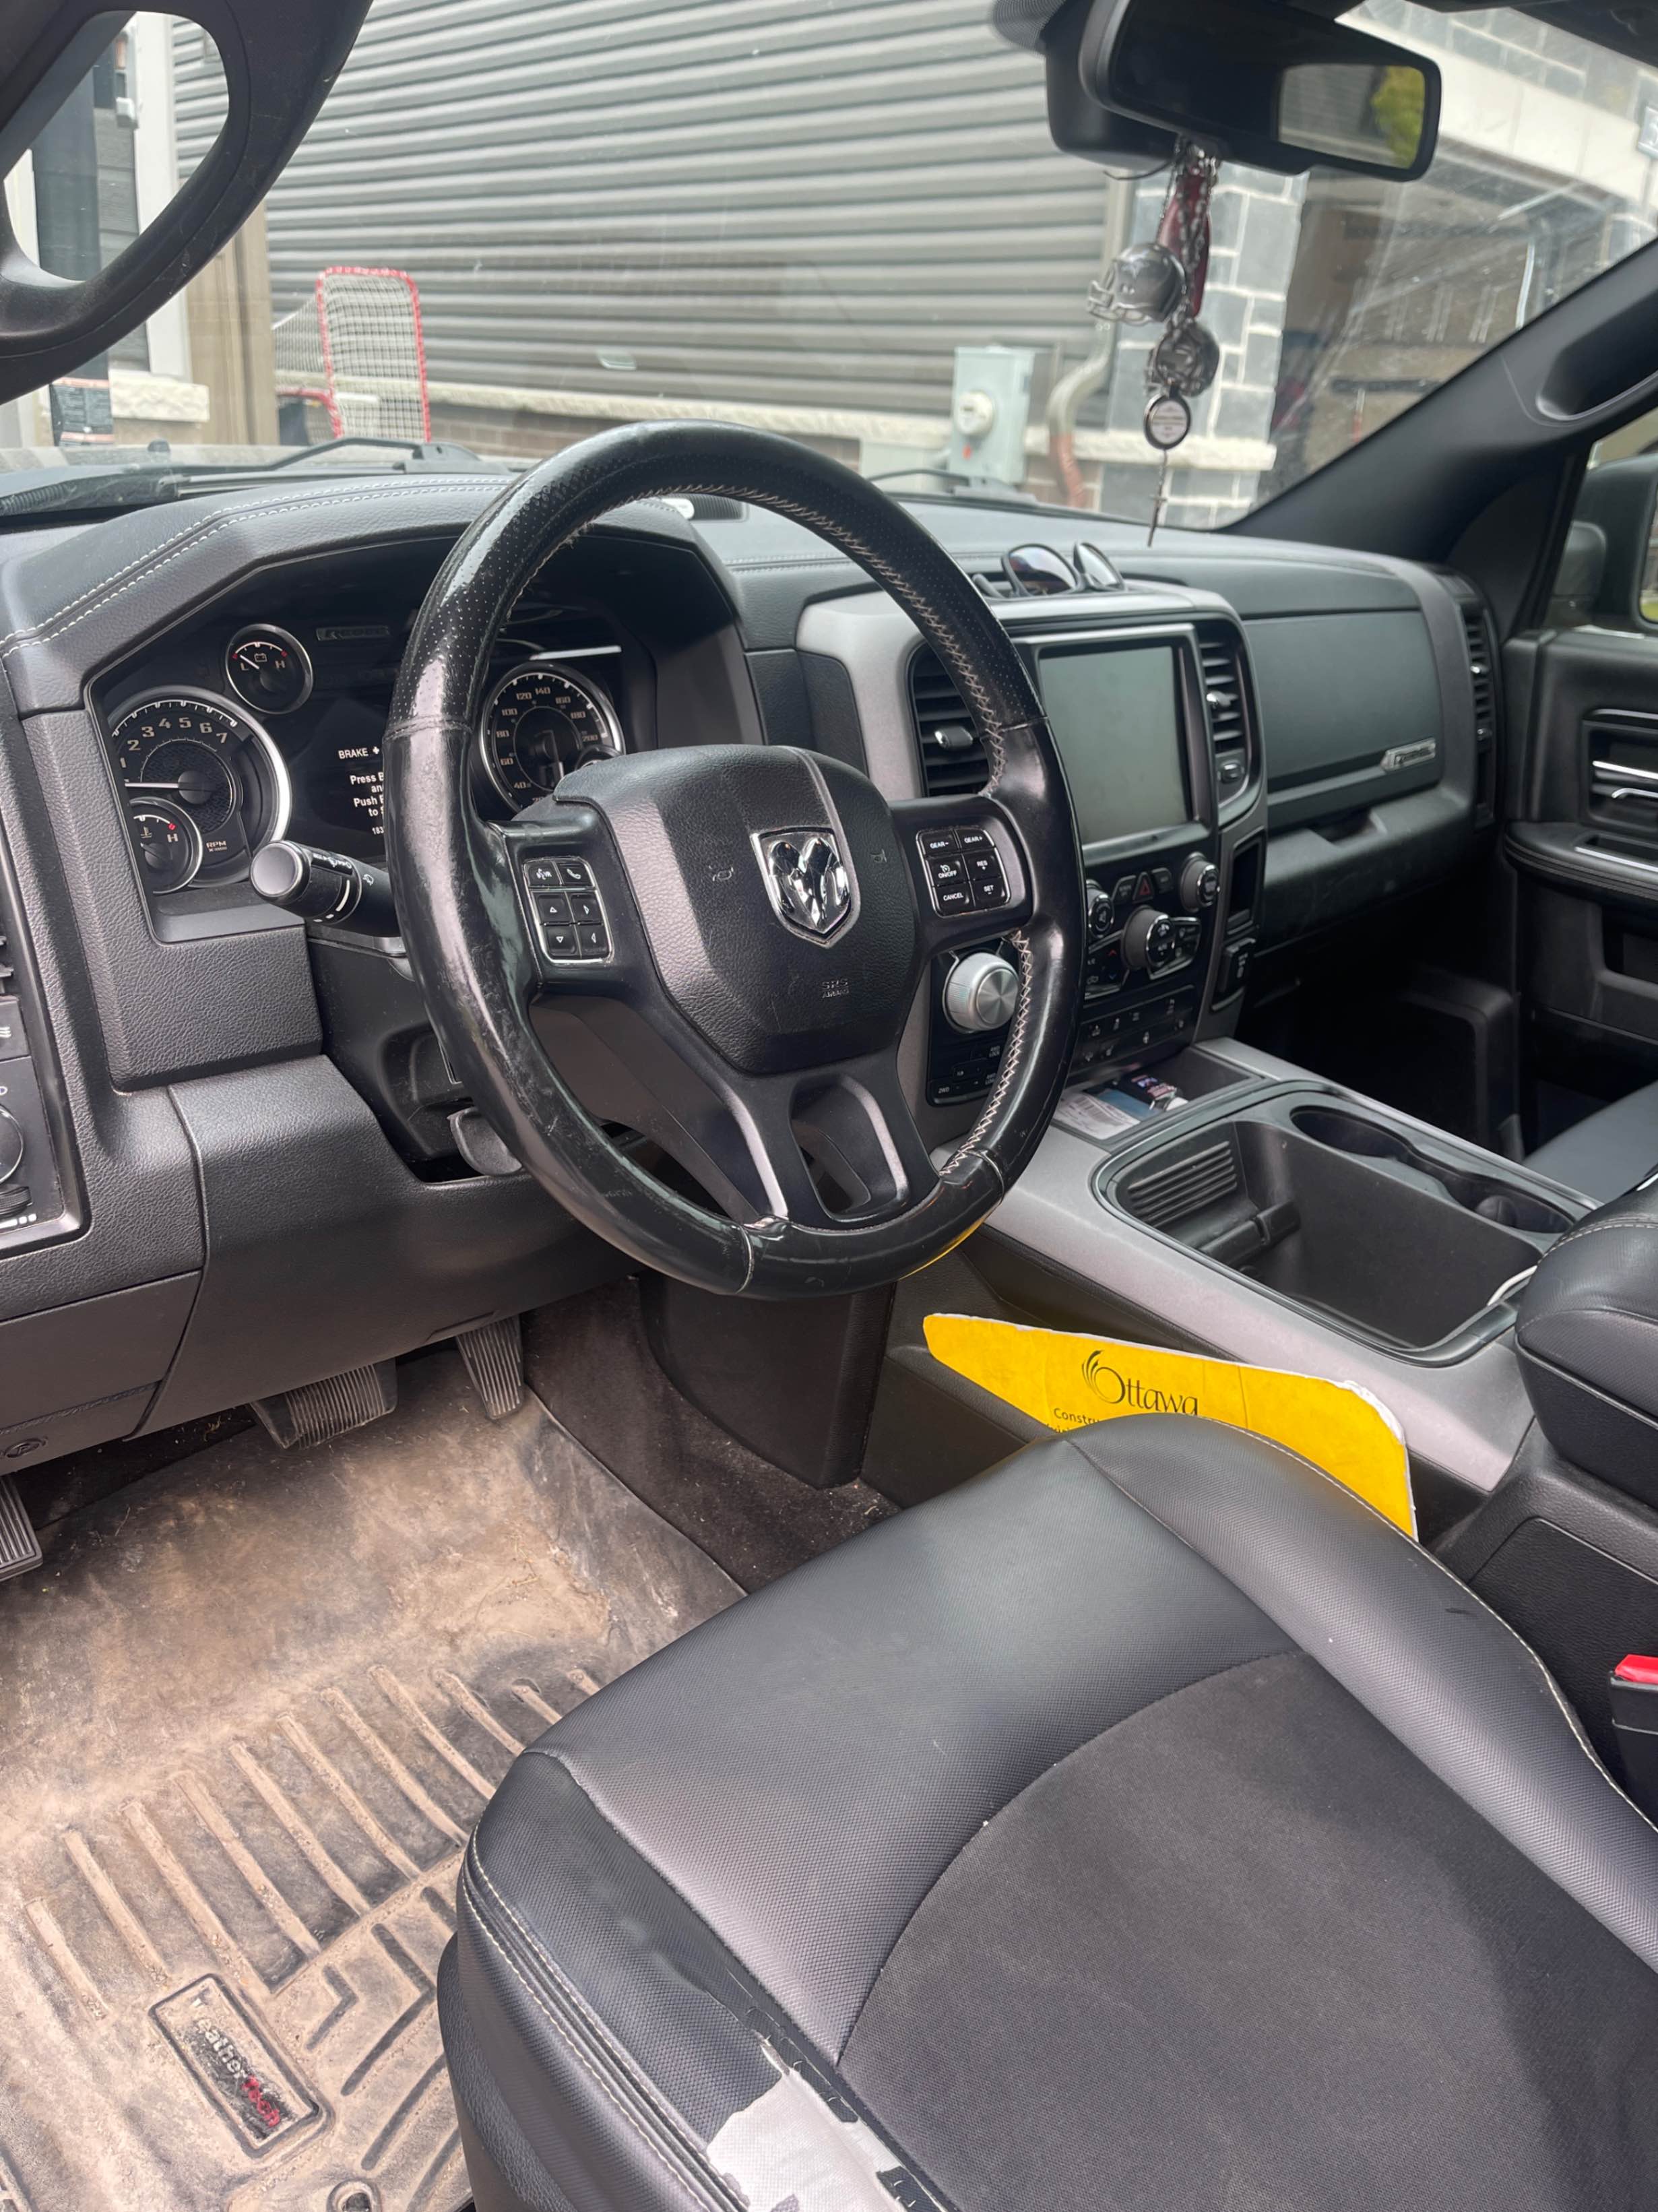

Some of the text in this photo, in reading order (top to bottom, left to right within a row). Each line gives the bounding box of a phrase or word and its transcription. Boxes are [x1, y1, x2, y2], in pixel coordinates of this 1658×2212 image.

[241, 663, 249, 671] L
[275, 660, 286, 669] H
[516, 687, 550, 701] 120 140
[501, 708, 518, 716] 100
[127, 740, 141, 751] 2
[141, 726, 155, 738] 3
[158, 718, 172, 728] 4
[179, 718, 192, 728] 5
[199, 722, 212, 734] 6
[216, 732, 228, 743] 7
[496, 730, 510, 738] 80
[338, 747, 369, 759] BRAKE
[500, 757, 514, 766] 60
[350, 774, 377, 785] Press
[371, 785, 384, 793] an
[513, 782, 527, 790] 40
[353, 796, 378, 807] Push
[369, 808, 379, 817] to
[372, 826, 384, 835] 183
[167, 833, 179, 842] H
[943, 892, 964, 901] CANCEL
[1082, 1350, 1199, 1416] Ottawa
[1054, 1408, 1100, 1425] Constru
